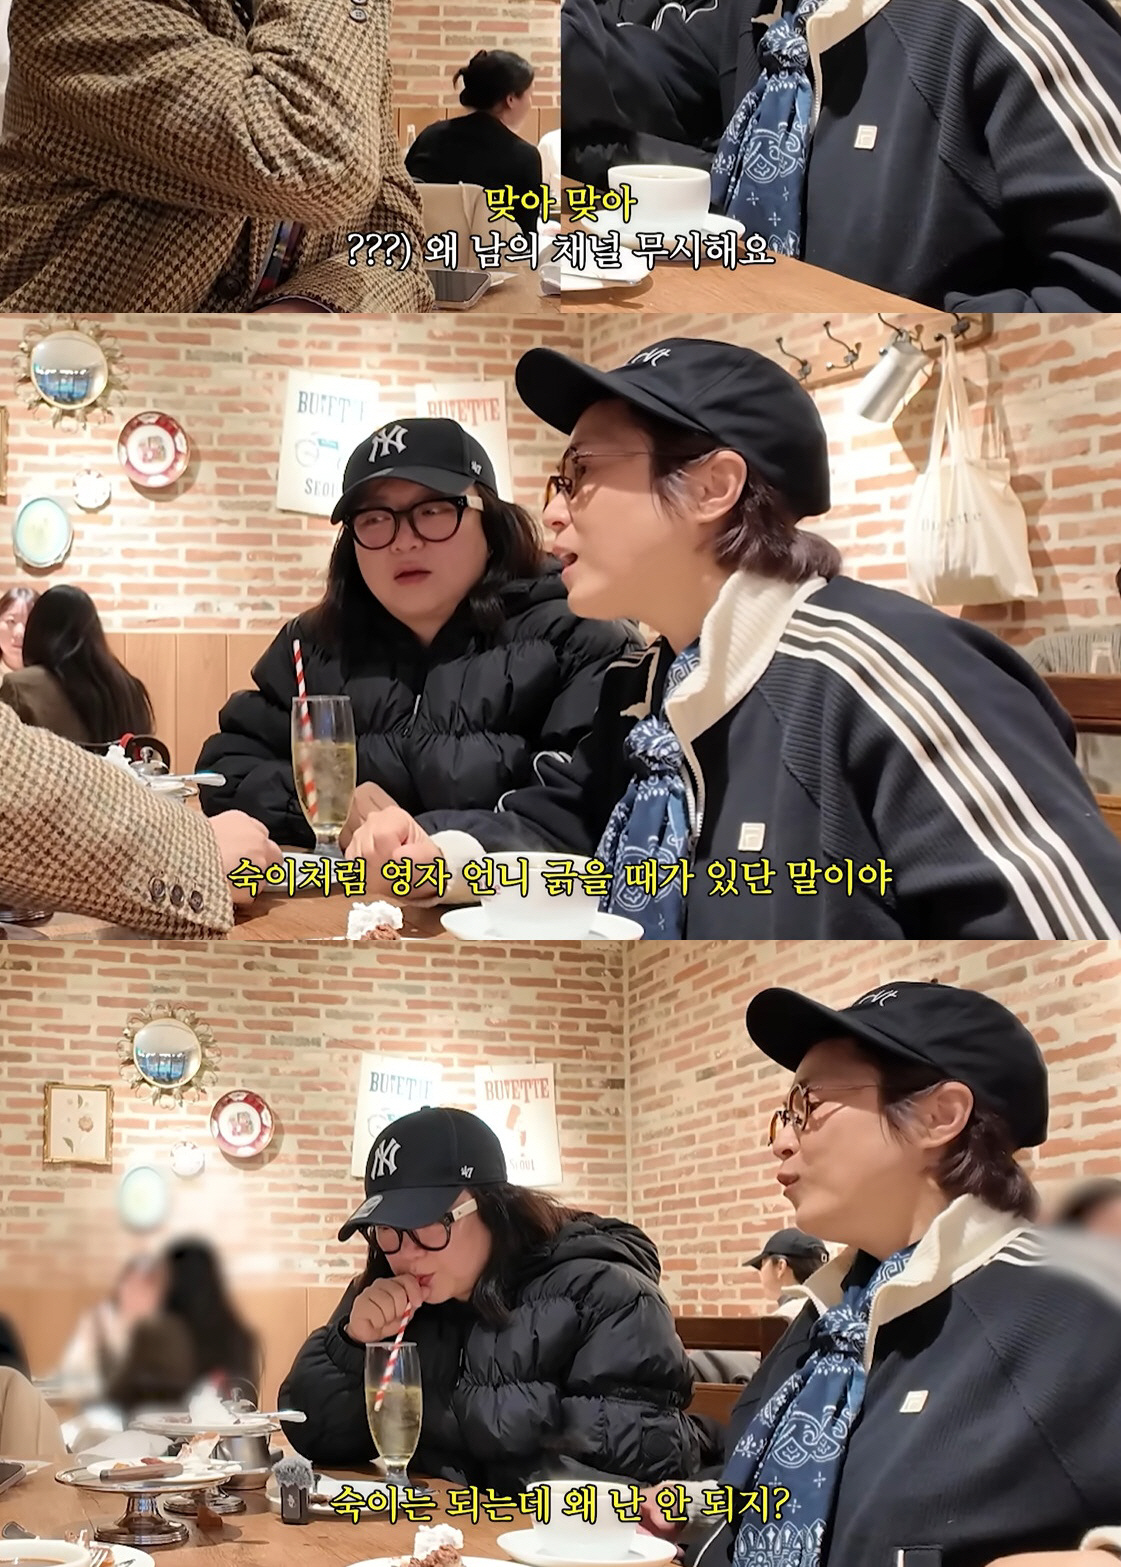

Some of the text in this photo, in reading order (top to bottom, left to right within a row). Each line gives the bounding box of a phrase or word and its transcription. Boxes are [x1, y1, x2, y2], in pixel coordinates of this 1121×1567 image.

[368, 425, 409, 463] NY
[485, 1077, 550, 1103] BUVETTE
[370, 1138, 401, 1180] NY
